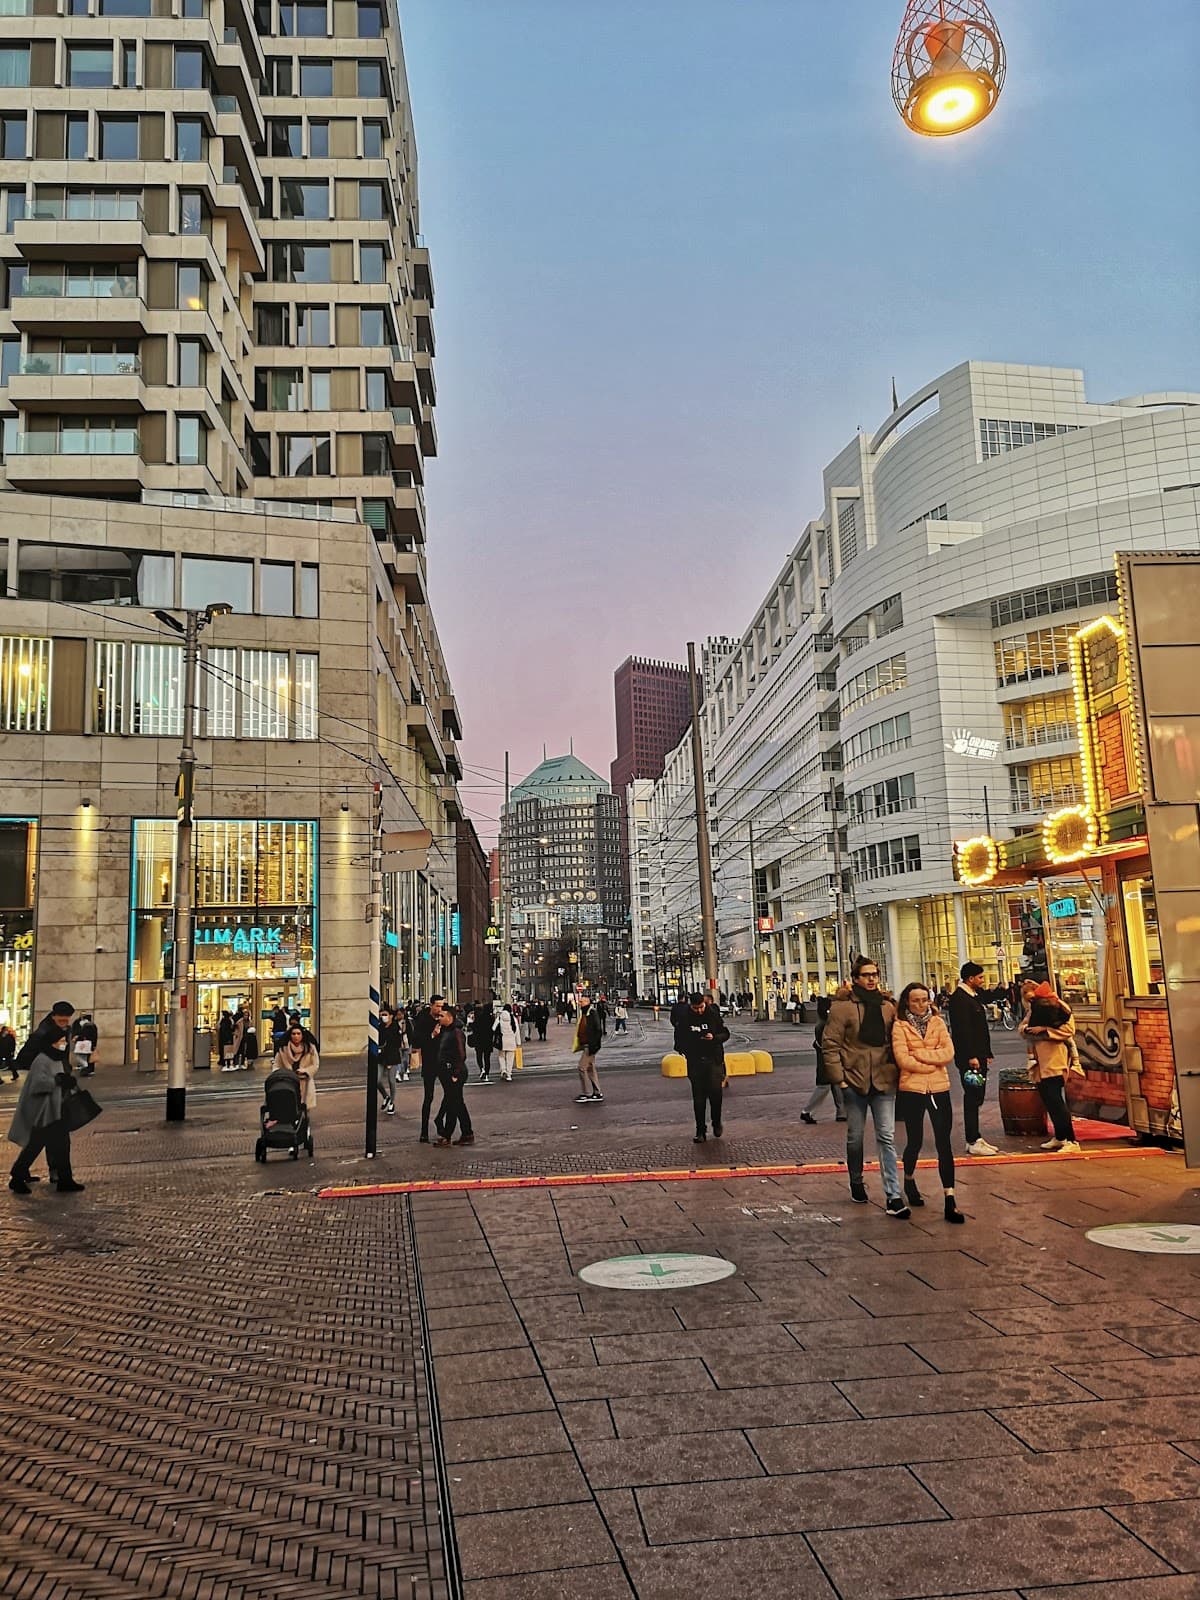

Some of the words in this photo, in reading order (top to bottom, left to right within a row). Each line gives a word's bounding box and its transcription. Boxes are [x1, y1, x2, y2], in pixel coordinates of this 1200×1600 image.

[969, 736, 1001, 751] ORANGE
[966, 746, 978, 756] THE
[195, 927, 281, 945] RIMARK
[234, 943, 289, 954] PRIMAR
